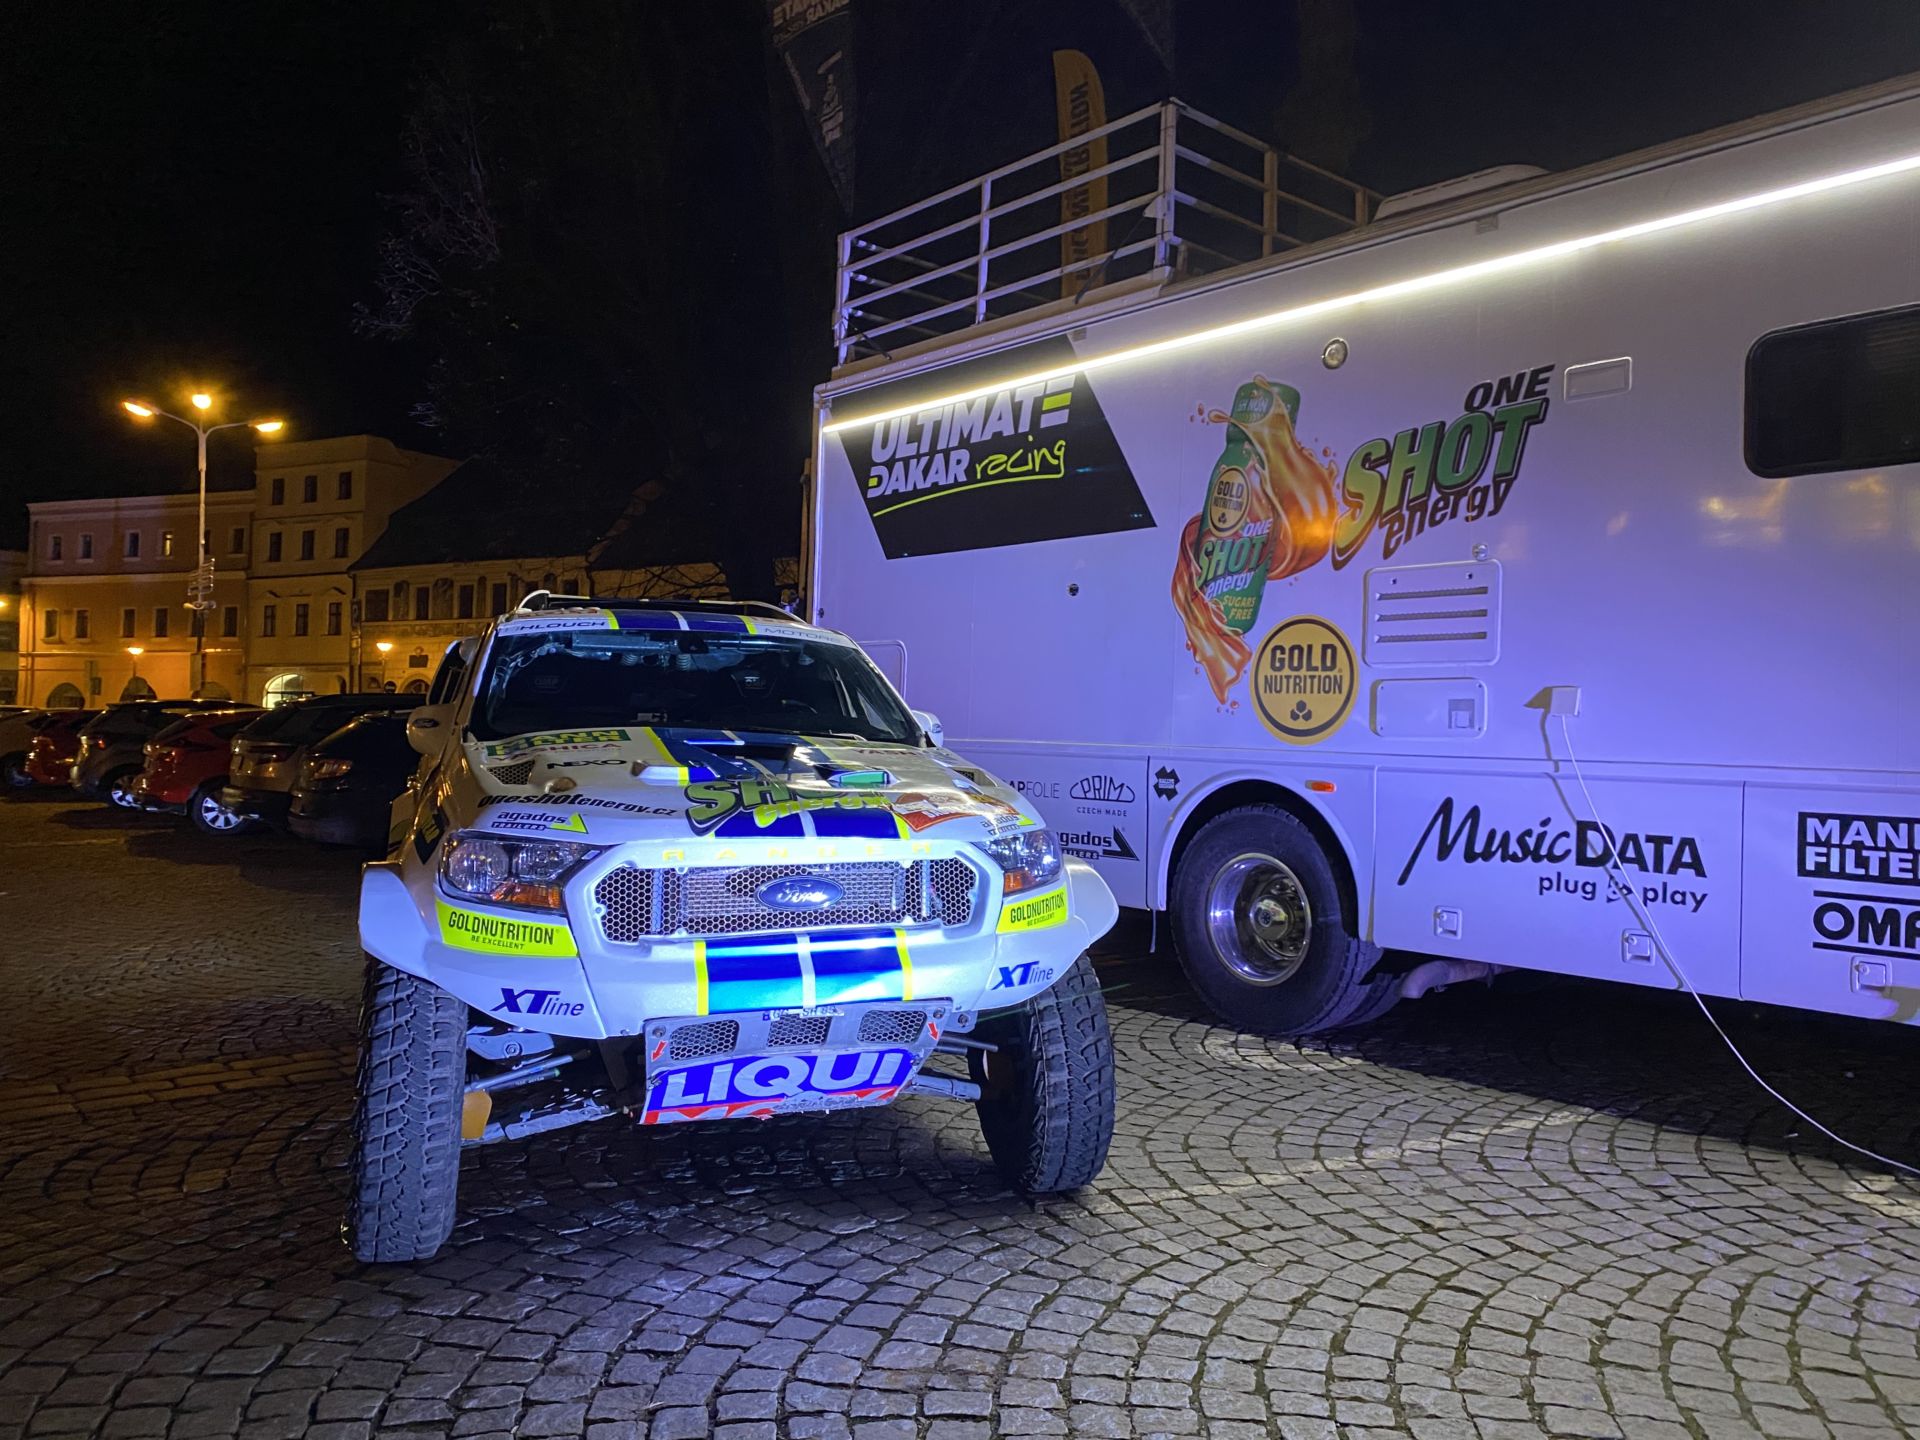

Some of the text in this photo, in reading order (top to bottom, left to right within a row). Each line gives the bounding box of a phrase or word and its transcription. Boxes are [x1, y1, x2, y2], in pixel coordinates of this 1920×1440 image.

[1463, 364, 1555, 412] ONE
[871, 375, 1076, 463] ULTIMATE
[975, 435, 1066, 480] racing
[867, 449, 970, 498] DAKAR
[1331, 399, 1550, 570] SHOT
[1216, 480, 1244, 499] GOLD
[1213, 496, 1243, 512] NUTRITION
[1243, 519, 1273, 537] ONE
[1382, 480, 1514, 560] energy
[1198, 535, 1267, 588] SHOT
[1206, 572, 1254, 600] energy
[1222, 595, 1257, 608] SUGARS
[1228, 608, 1253, 620] FREE
[520, 621, 605, 631] HLOUCH
[1270, 643, 1338, 672] GOLD
[1263, 675, 1344, 695] NUTRITION
[547, 759, 628, 770] NEXO
[1004, 780, 1061, 799] APFOLIE
[1080, 775, 1126, 801] PRIM
[477, 793, 678, 818] oneshotenergy.cz
[497, 811, 569, 824] agados
[1076, 806, 1128, 817] CZECH MADE
[490, 822, 546, 830] TRAILERS
[981, 814, 1020, 828] aados
[1806, 817, 1920, 850] MAN
[1057, 831, 1112, 848] gados
[1062, 848, 1099, 859] AILERS
[1806, 846, 1920, 879] FILTE
[1538, 871, 1597, 902] plug
[1642, 881, 1709, 913] play
[1010, 893, 1065, 924] GOLDNUTRITION
[449, 911, 554, 945] GOLDNUTRITION
[471, 935, 525, 950] BE EXCELLENT
[662, 1051, 905, 1108] LIQUI
